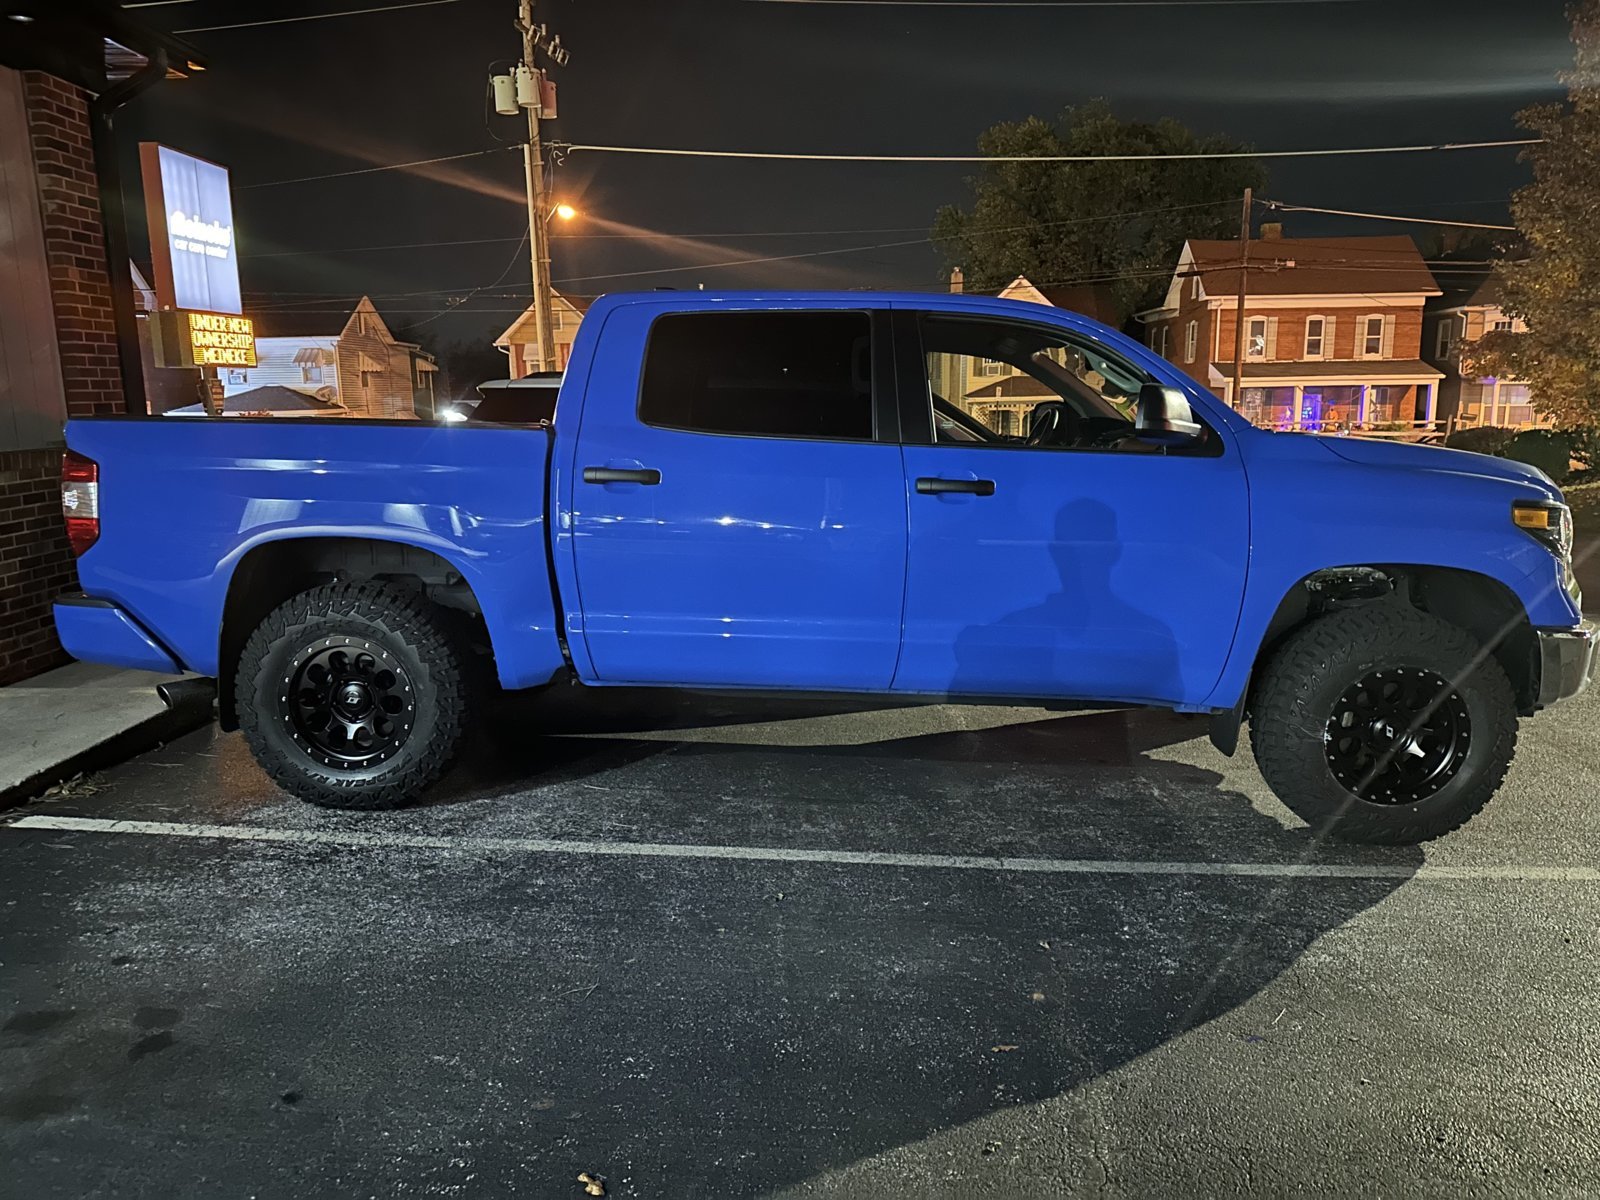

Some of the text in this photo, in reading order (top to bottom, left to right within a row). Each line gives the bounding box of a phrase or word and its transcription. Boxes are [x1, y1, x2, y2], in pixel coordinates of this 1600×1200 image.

[192, 314, 249, 334] UNDER NEW
[193, 330, 254, 349] OWNERSHIP
[203, 347, 248, 365] MEINEKE
